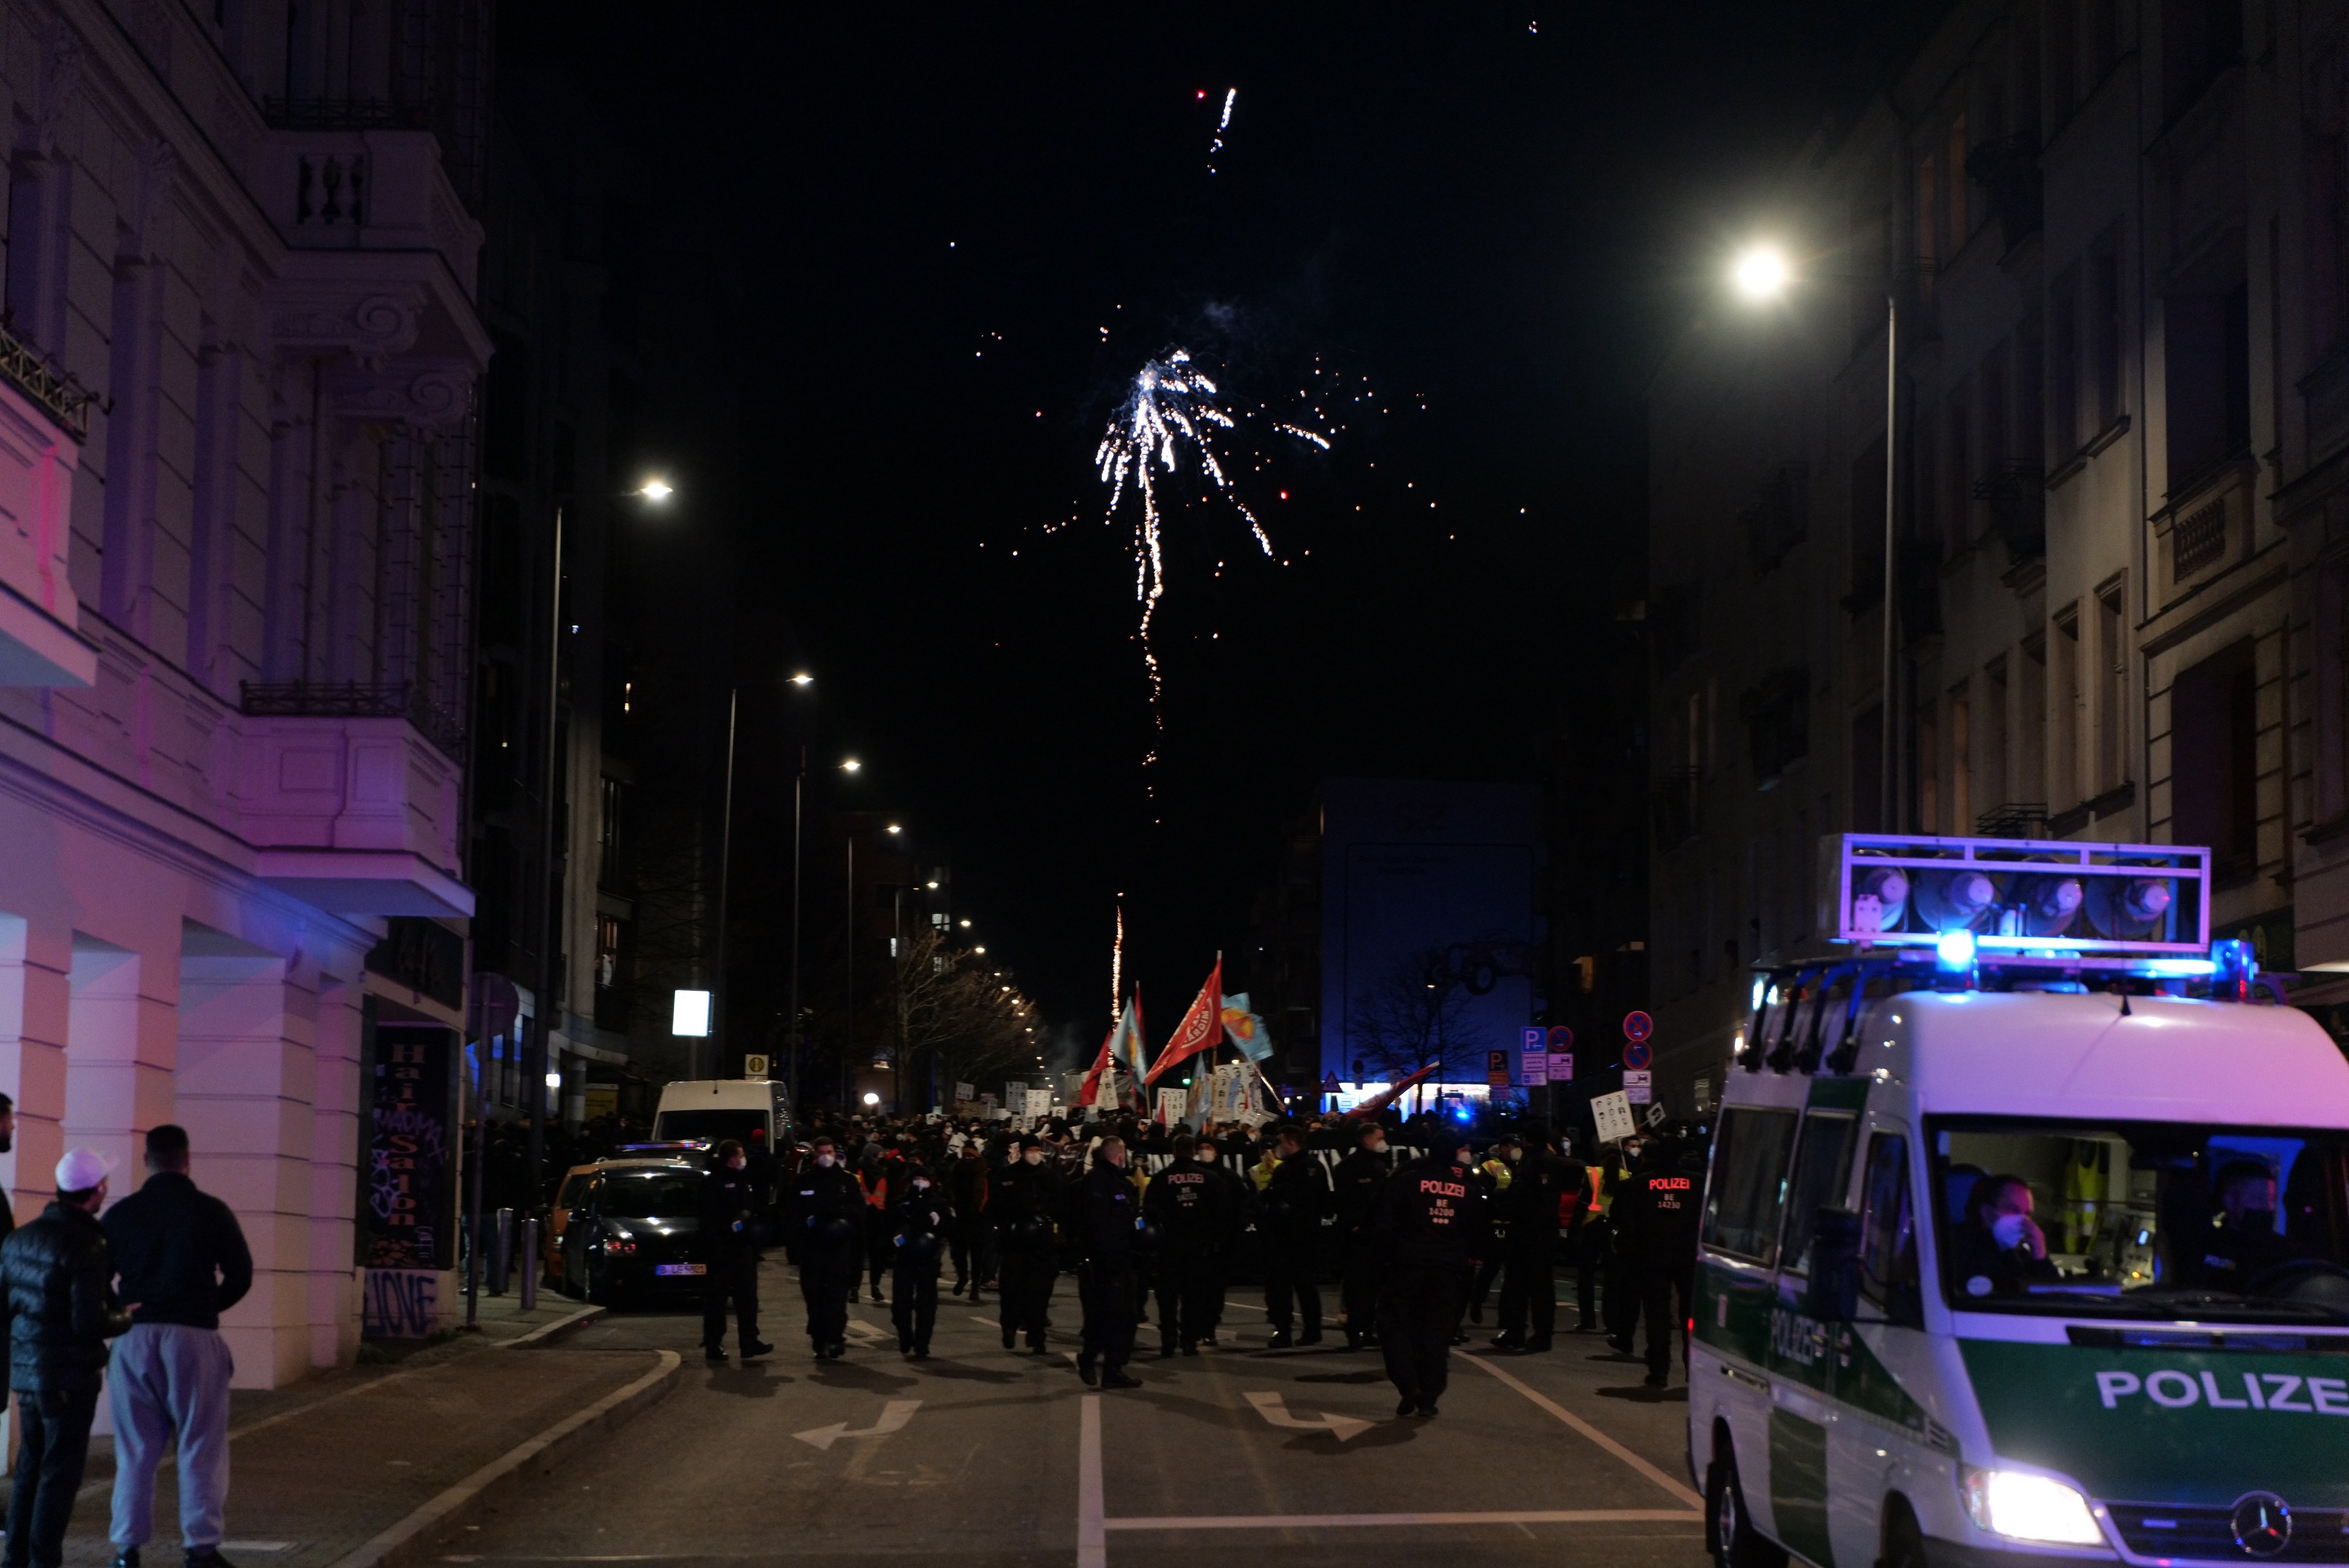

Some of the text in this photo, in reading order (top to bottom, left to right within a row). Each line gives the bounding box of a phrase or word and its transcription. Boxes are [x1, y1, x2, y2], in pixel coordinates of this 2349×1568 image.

[1525, 1030, 1540, 1050] P
[388, 1134, 419, 1225] Salon
[1167, 1173, 1204, 1185] POLIZEI
[1649, 1177, 1690, 1190] POLIZEI
[1421, 1180, 1465, 1197] POLIZEI
[1437, 1199, 1448, 1207] BE
